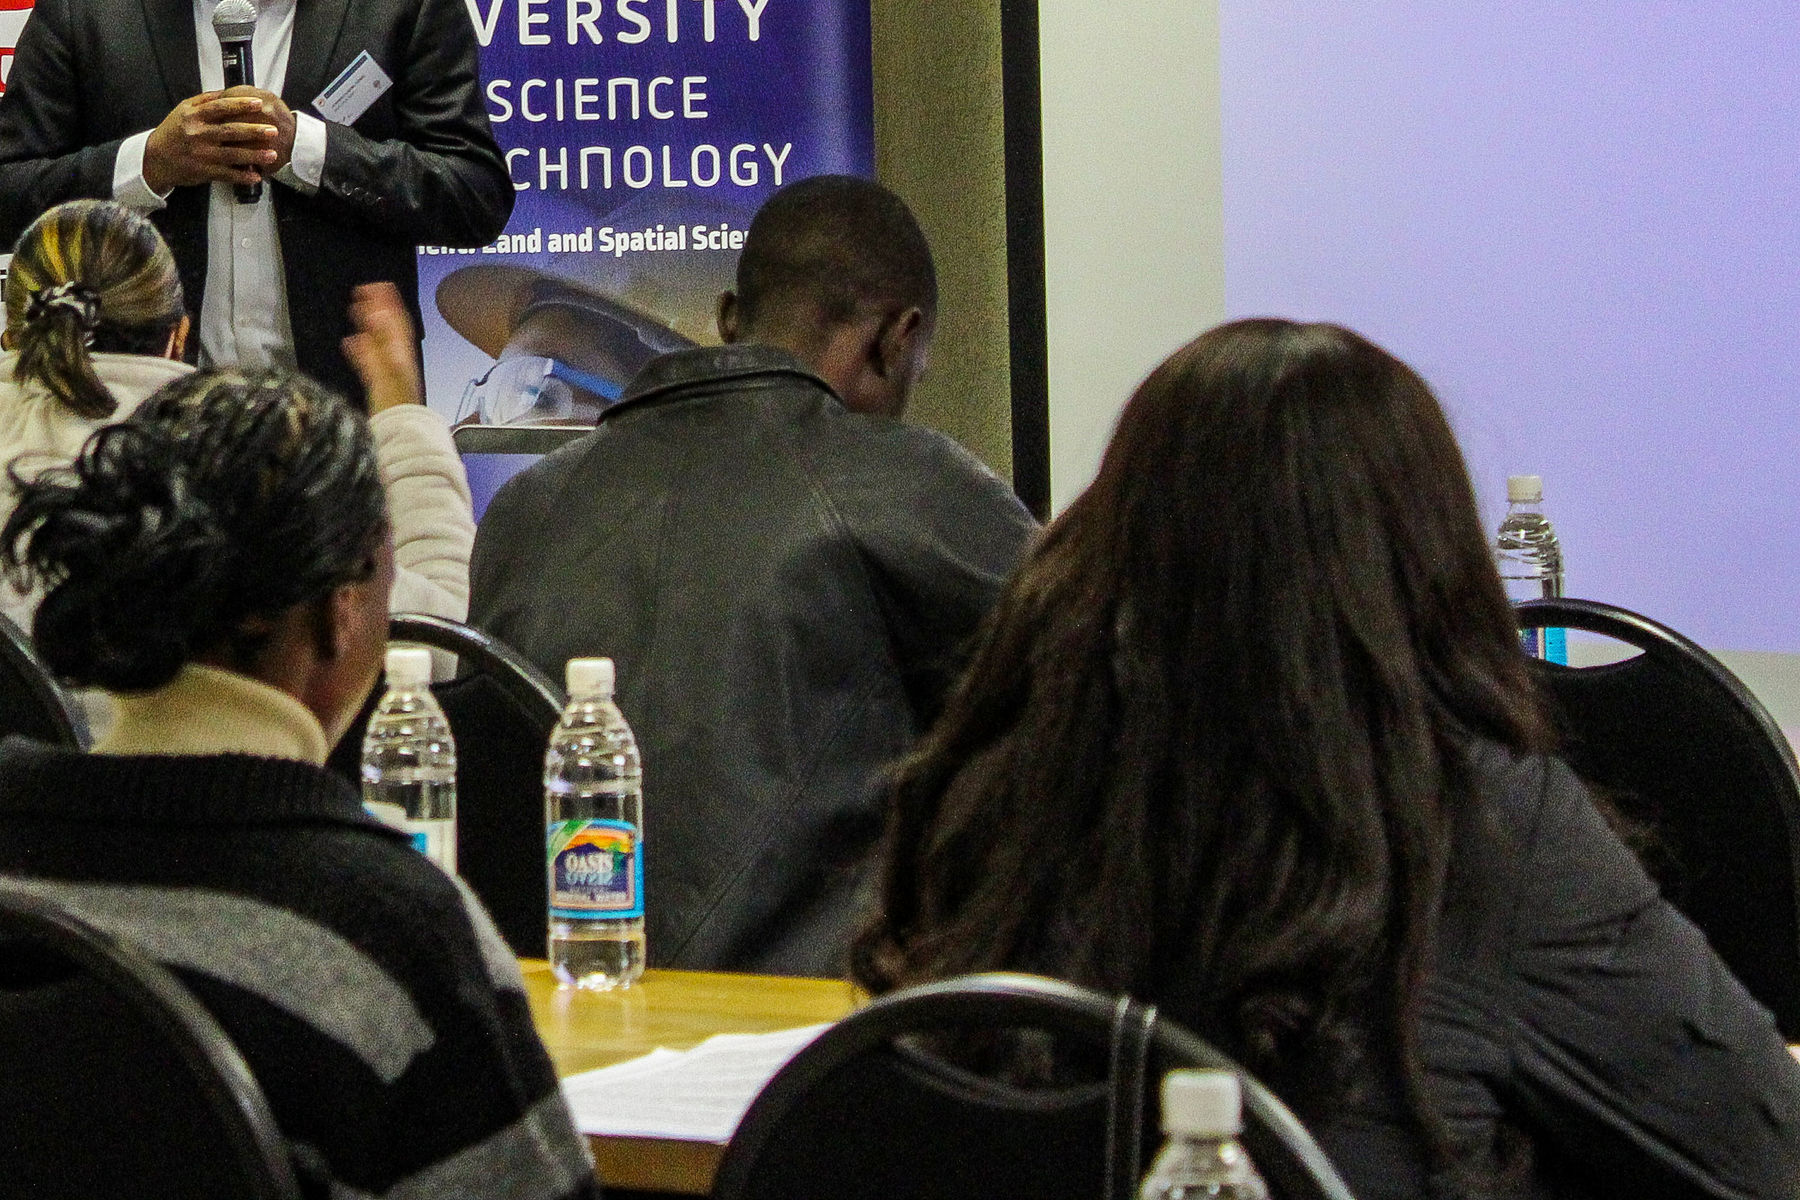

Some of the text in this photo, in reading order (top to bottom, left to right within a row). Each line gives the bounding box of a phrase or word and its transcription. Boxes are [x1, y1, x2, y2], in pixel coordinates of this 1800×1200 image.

[486, 76, 709, 123] SCIENCE
[505, 142, 792, 191] CHNOLOGY
[547, 226, 593, 254] and
[598, 224, 686, 257] Spatial
[691, 223, 749, 251] Scie
